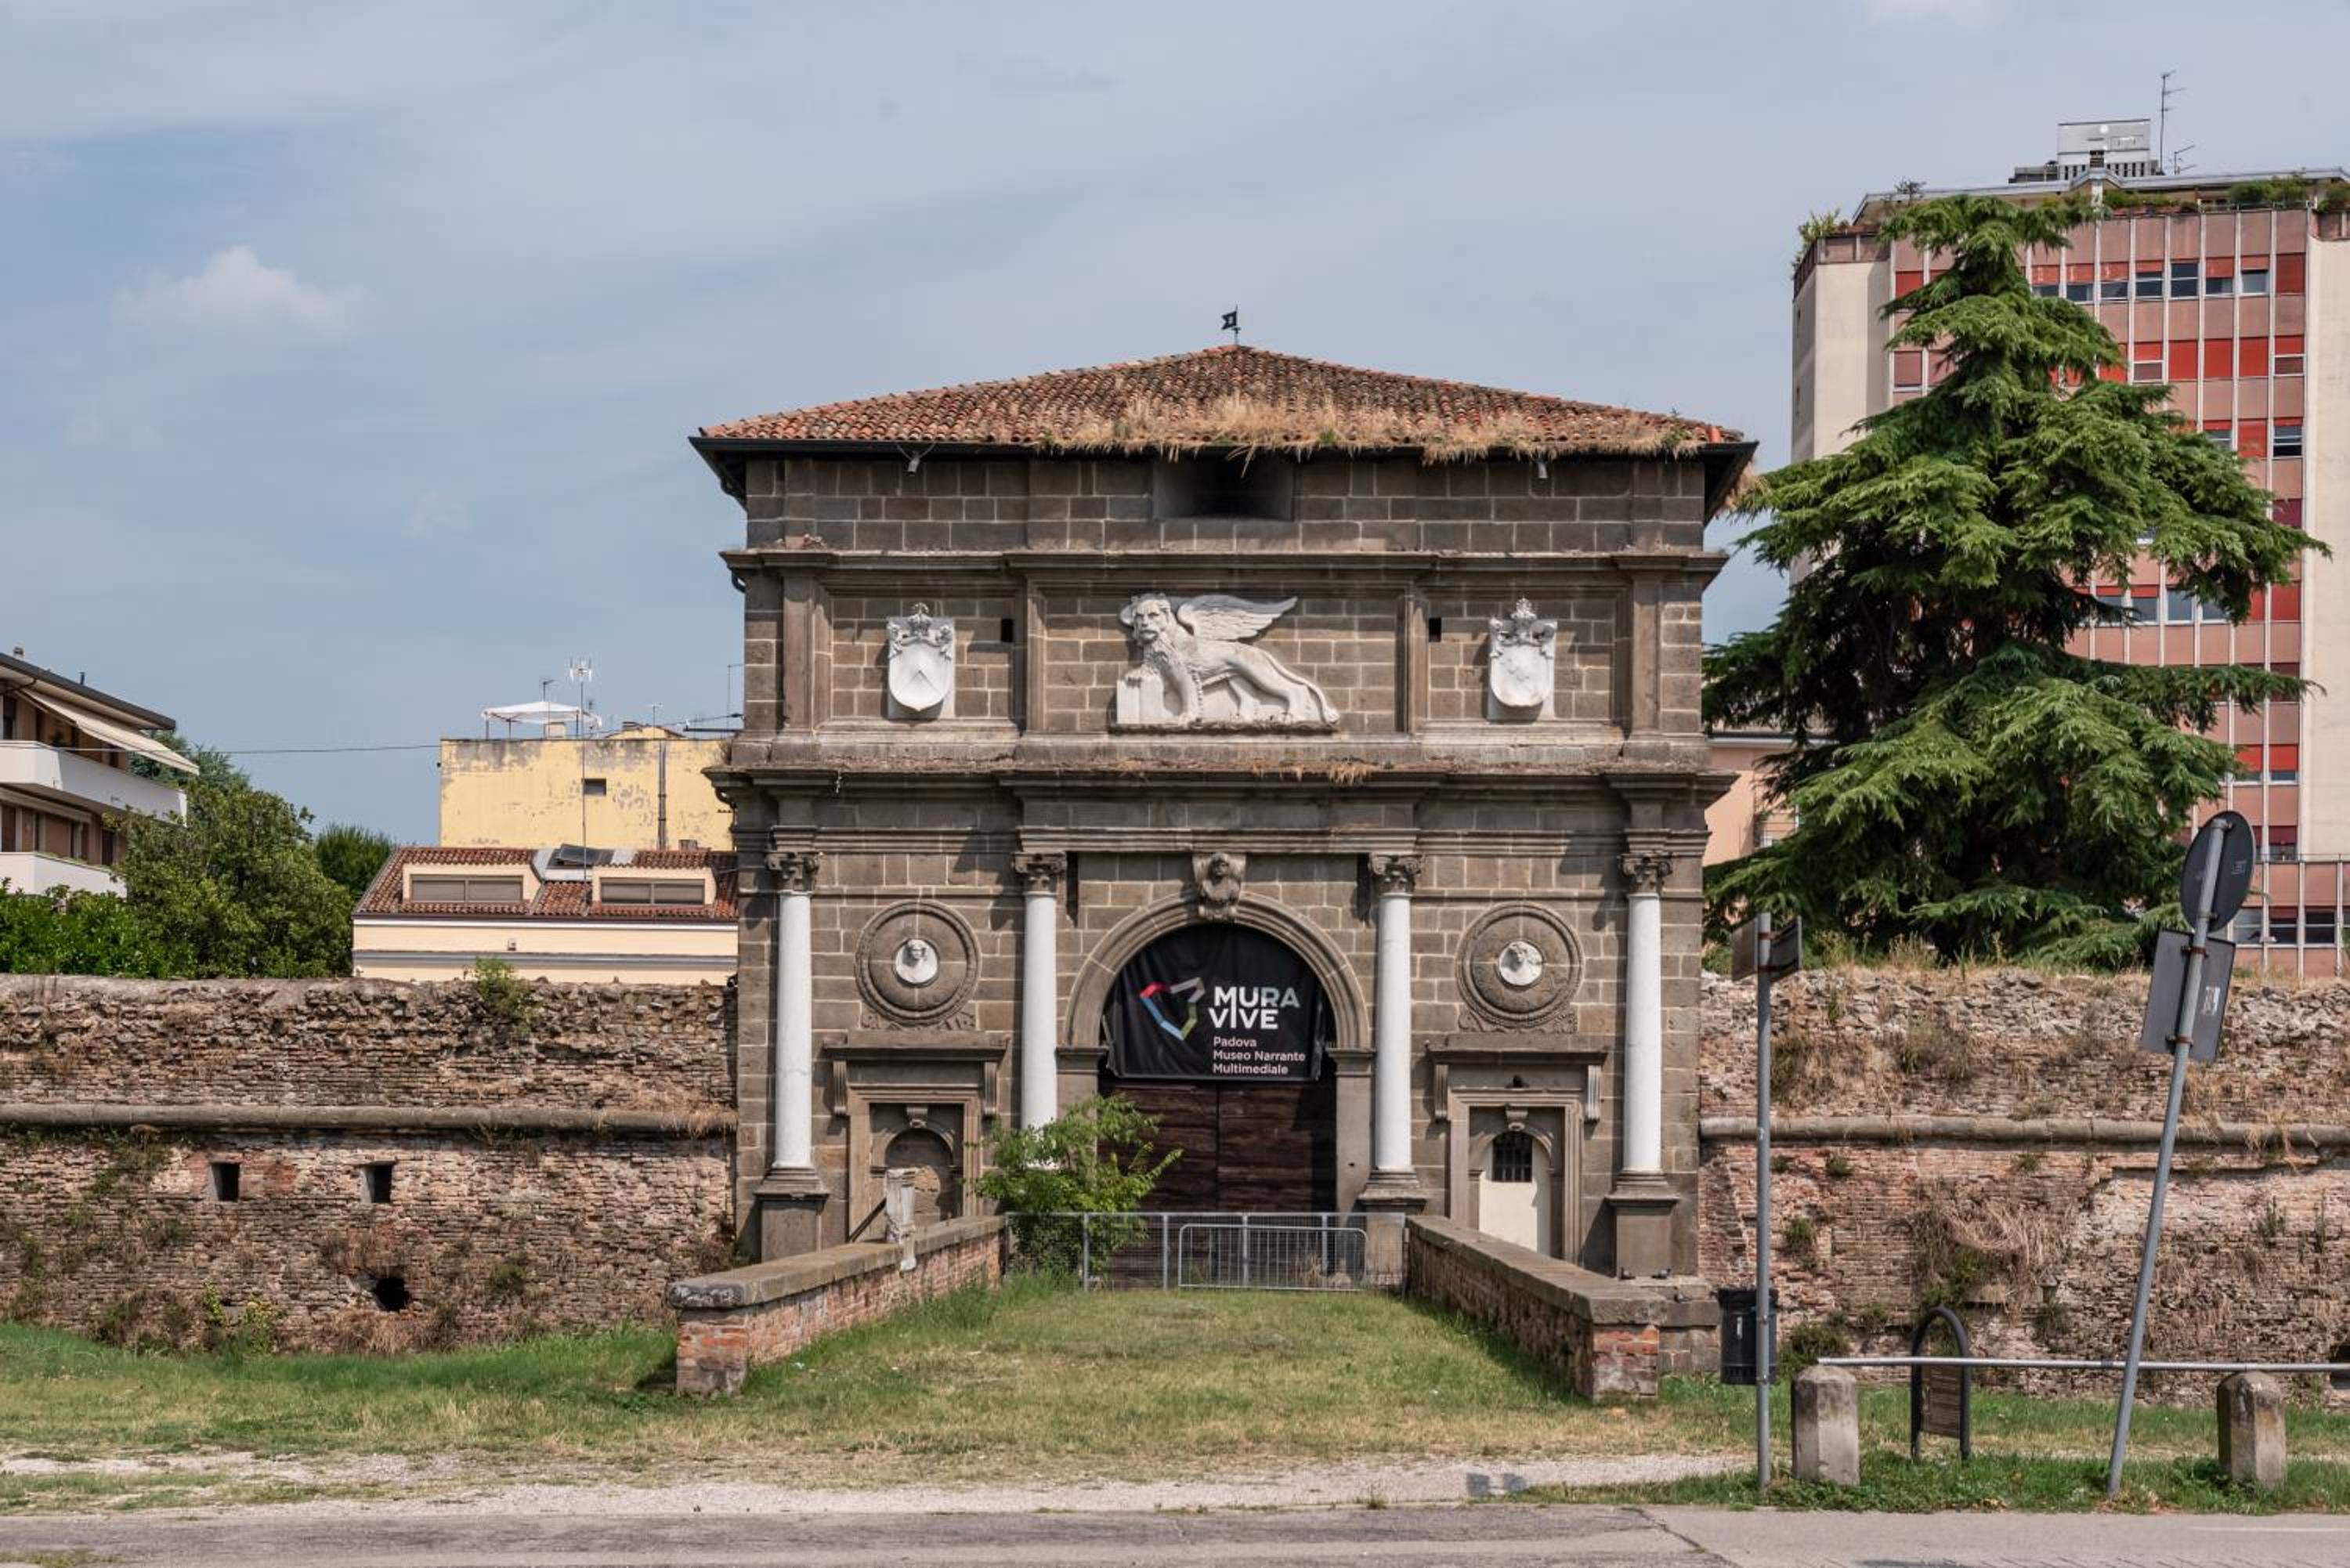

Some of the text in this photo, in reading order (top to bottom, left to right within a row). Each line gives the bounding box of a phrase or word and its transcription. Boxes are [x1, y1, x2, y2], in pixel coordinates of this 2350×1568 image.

[1214, 986, 1300, 1008] MURA
[1208, 1008, 1278, 1029] VIVE
[1213, 1035, 1256, 1047] Padova
[1213, 1050, 1306, 1061] Museo Narrante
[1213, 1063, 1289, 1075] Multimediale
